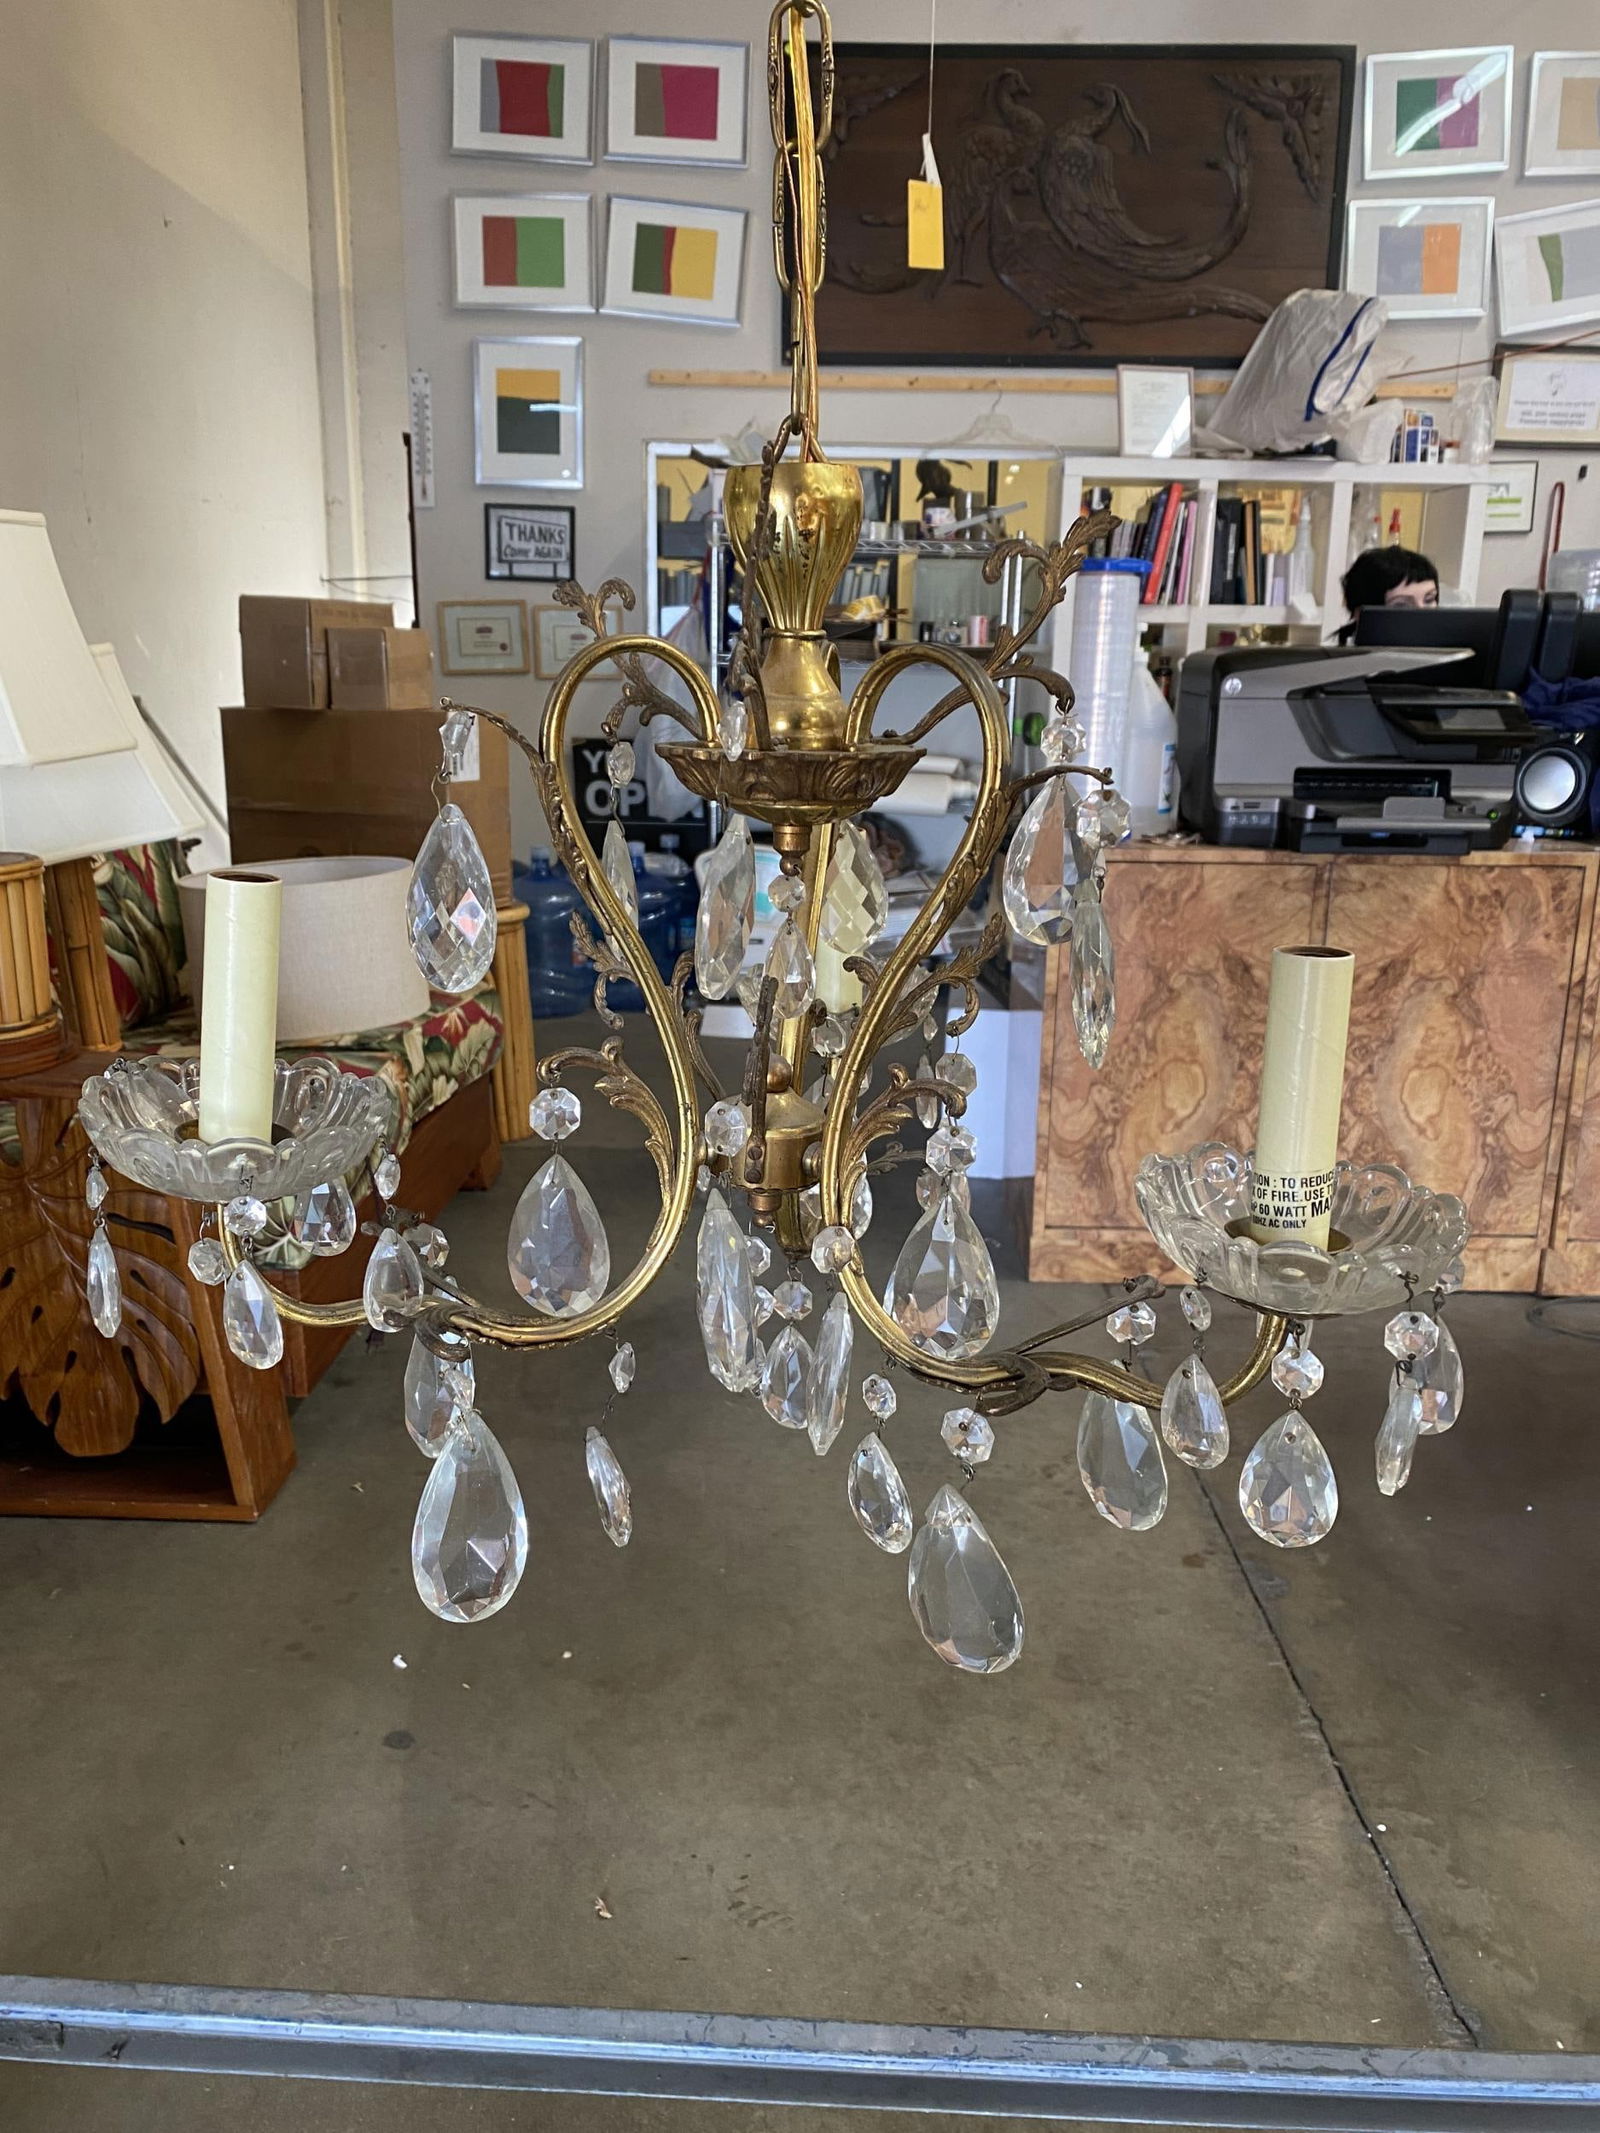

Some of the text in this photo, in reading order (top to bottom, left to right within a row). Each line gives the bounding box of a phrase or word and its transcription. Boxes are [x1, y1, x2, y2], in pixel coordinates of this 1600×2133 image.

[505, 522, 565, 545] THANKS
[1280, 1178, 1297, 1189] TO
[1257, 1187, 1268, 1199] OF
[1259, 1203, 1270, 1216] 60
[1273, 1206, 1307, 1218] WATT
[1268, 1218, 1280, 1228] AC
[1282, 1219, 1307, 1229] ONLY
